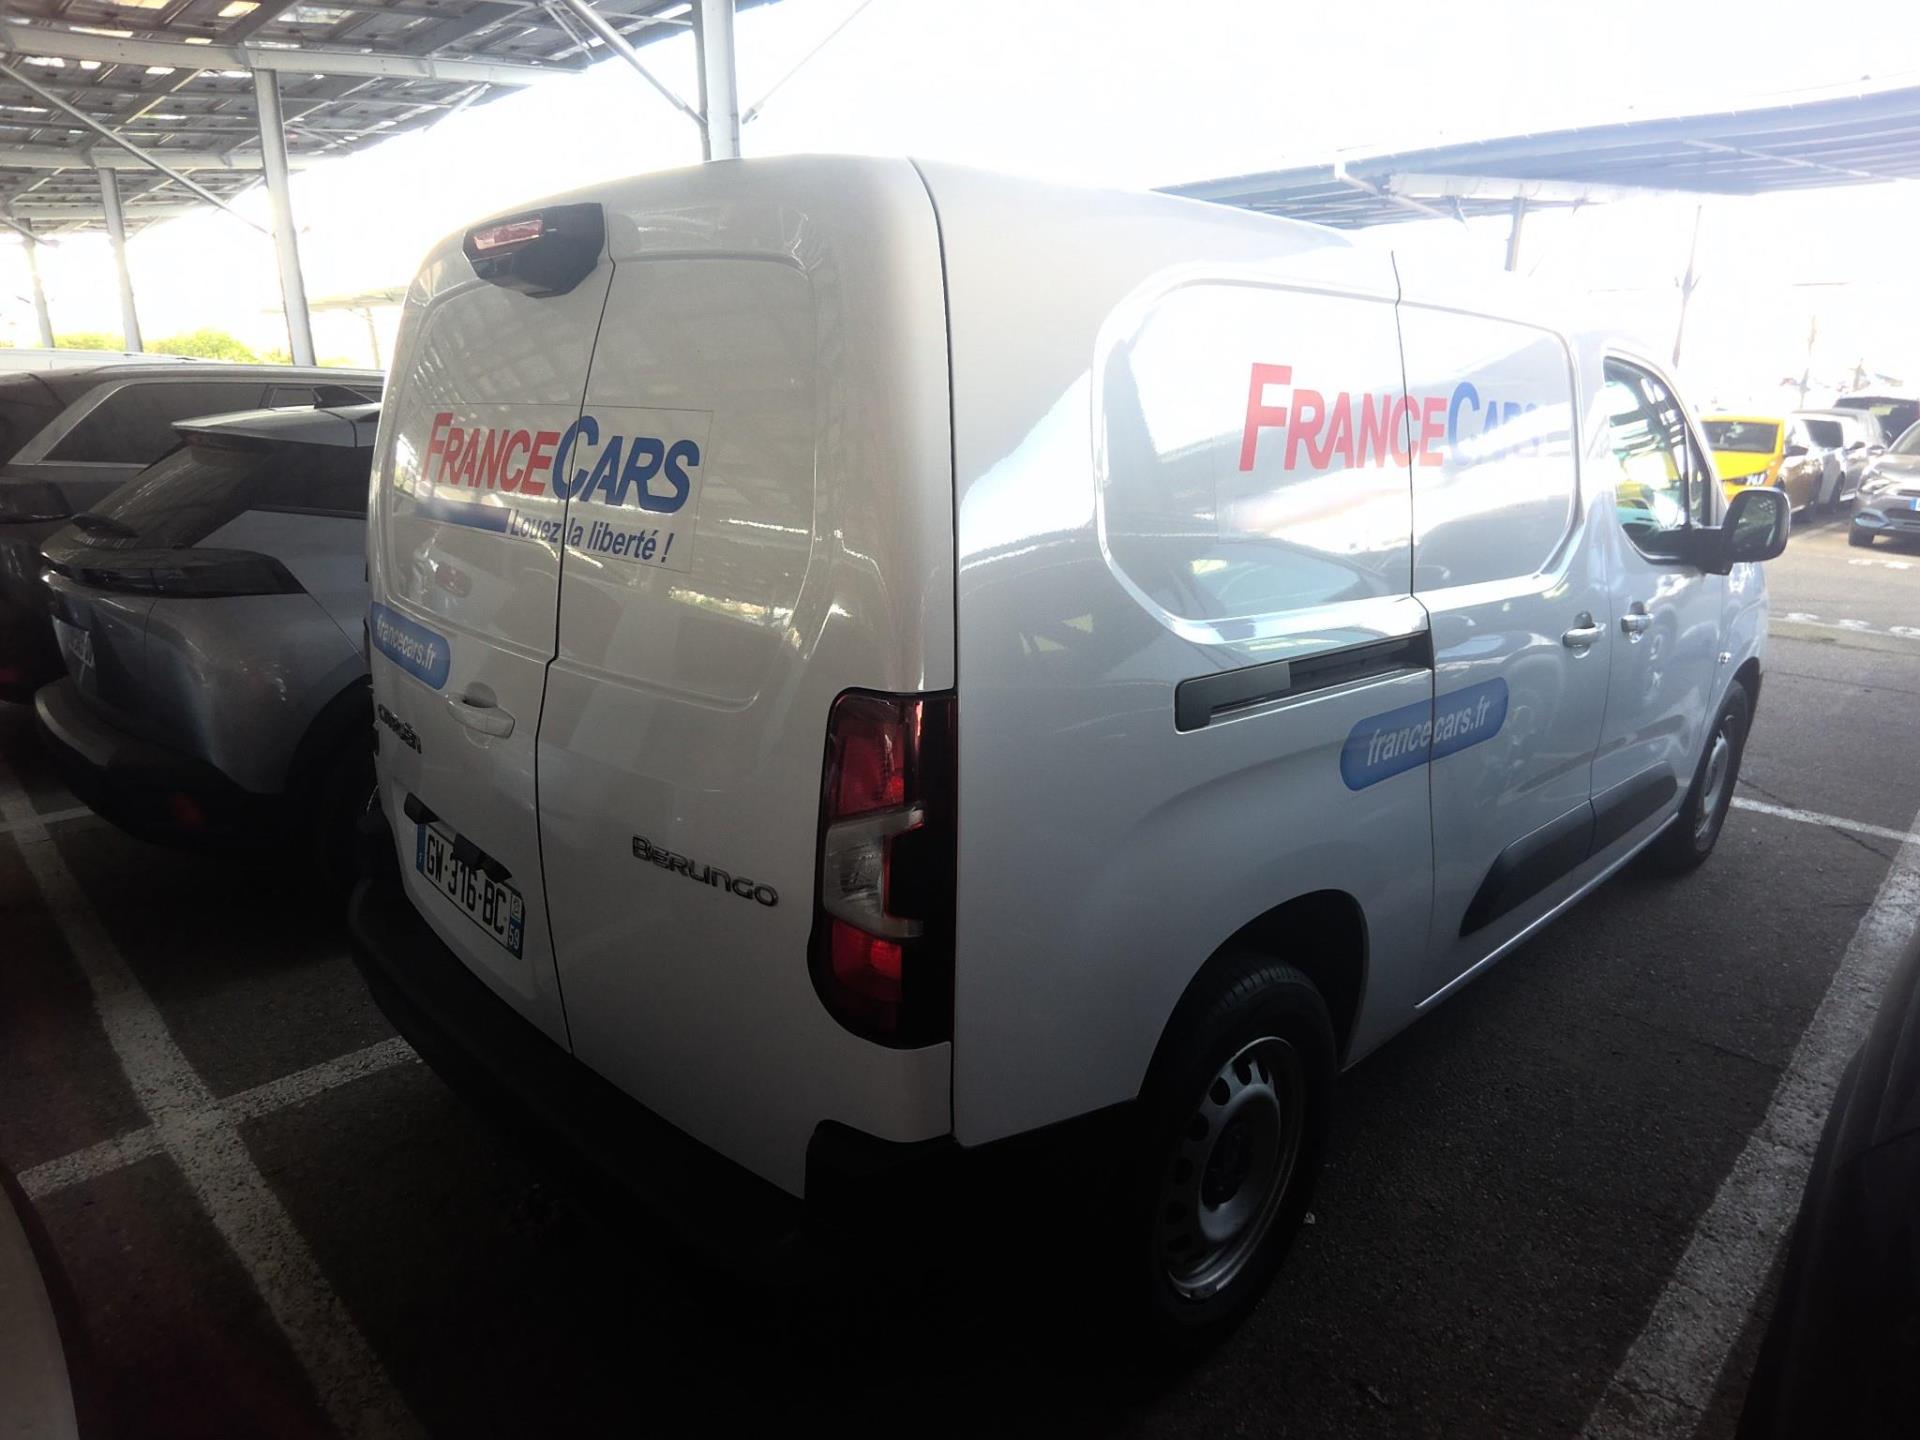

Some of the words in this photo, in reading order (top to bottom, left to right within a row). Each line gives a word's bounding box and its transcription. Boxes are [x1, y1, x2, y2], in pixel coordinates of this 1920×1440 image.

[510, 509, 563, 543] Louez
[566, 517, 584, 547] la
[587, 520, 657, 560] liberté
[1367, 696, 1491, 766] francecars.fr
[632, 834, 779, 907] BERLINGO
